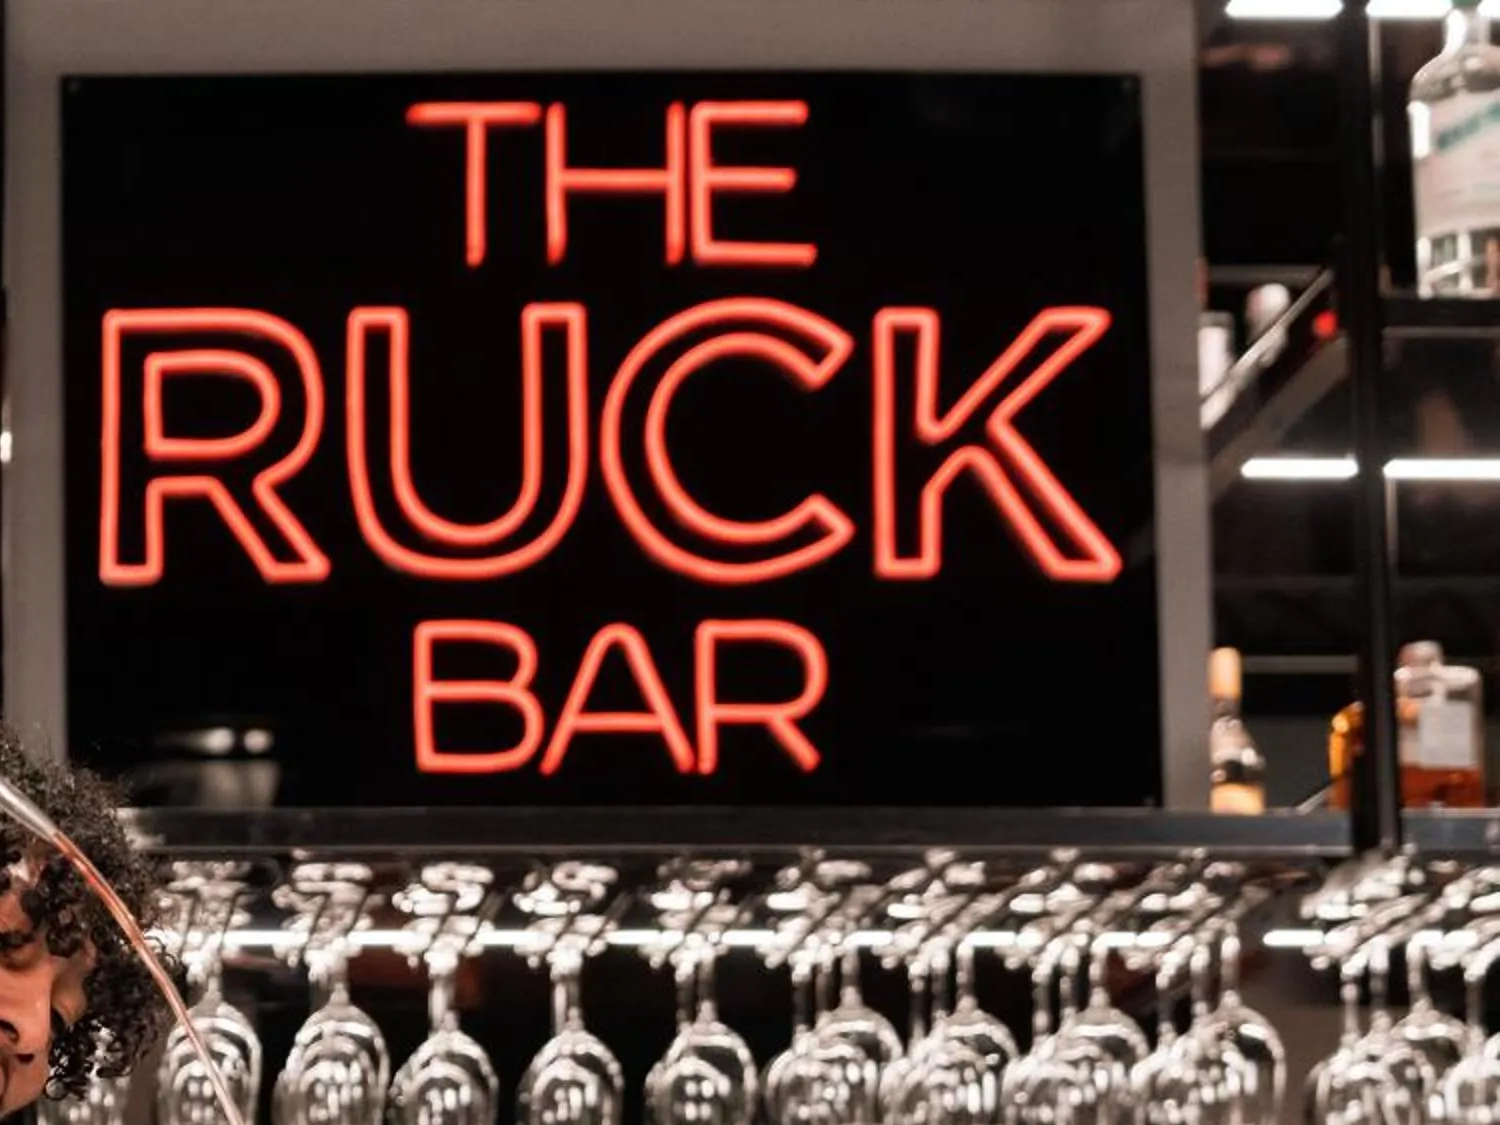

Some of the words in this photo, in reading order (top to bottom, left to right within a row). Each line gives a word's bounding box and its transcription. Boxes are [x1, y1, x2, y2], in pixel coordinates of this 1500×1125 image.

[408, 100, 816, 265] THE
[100, 297, 1122, 584] RUCK
[413, 620, 827, 774] BAR
